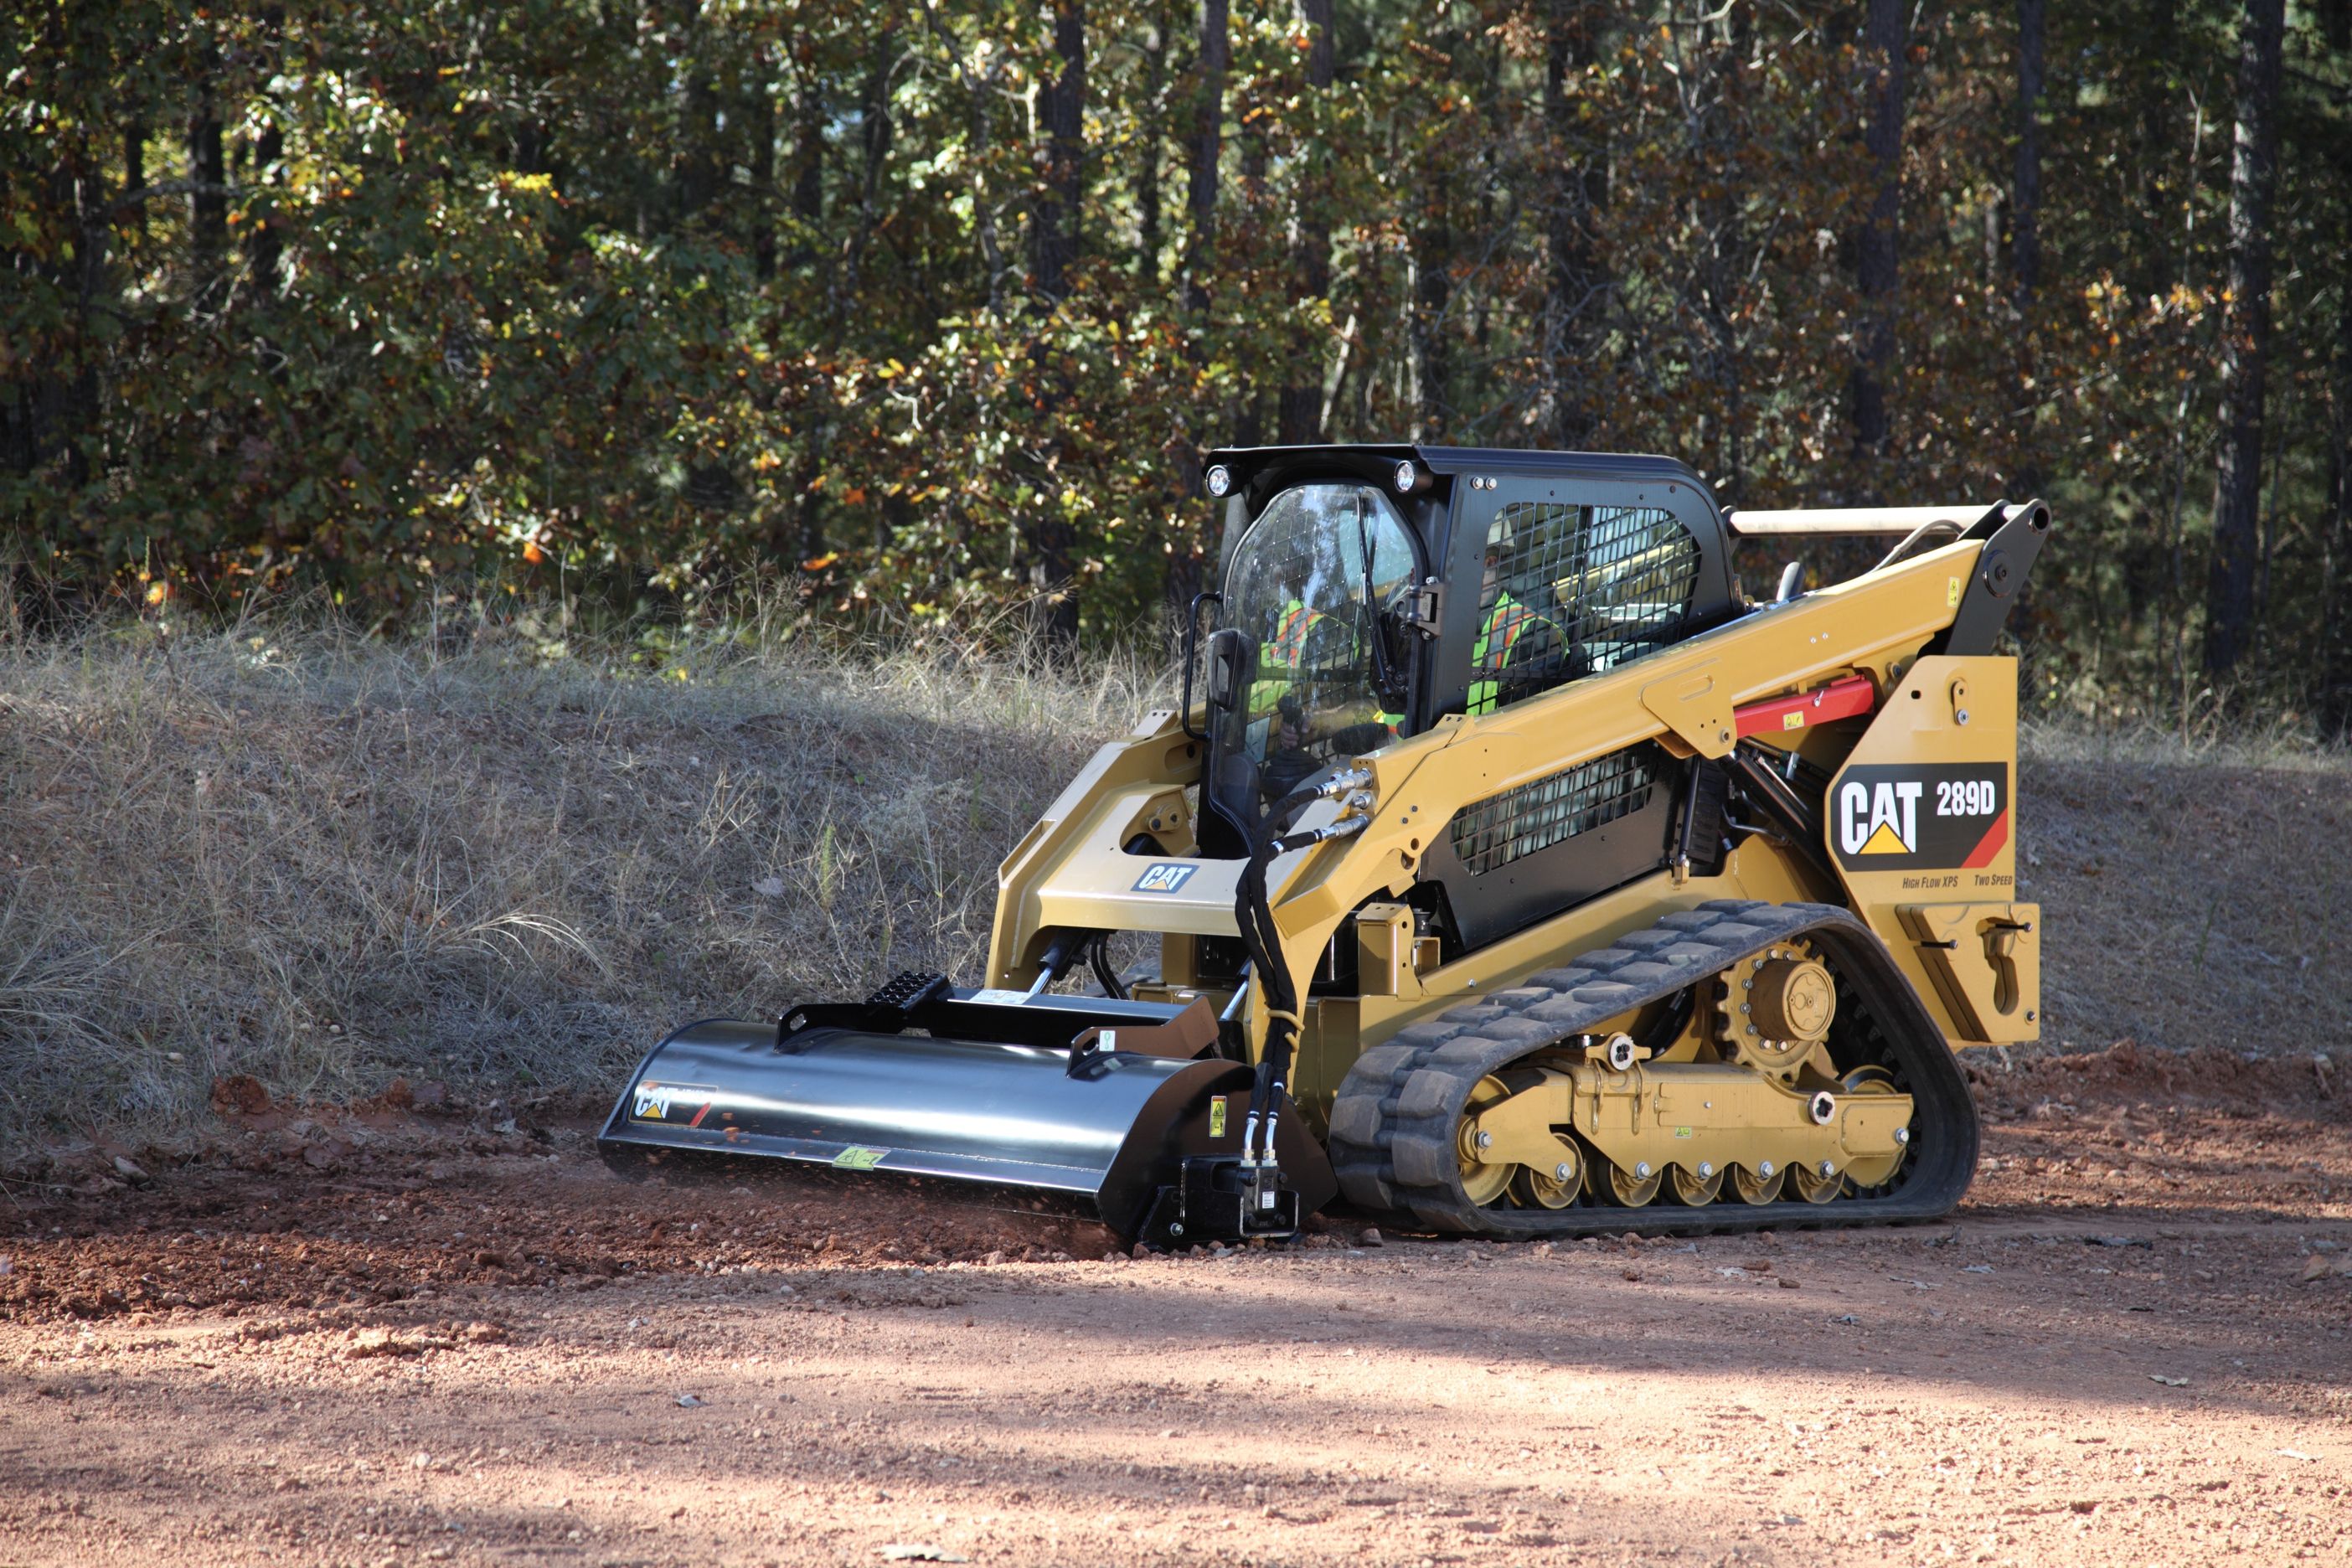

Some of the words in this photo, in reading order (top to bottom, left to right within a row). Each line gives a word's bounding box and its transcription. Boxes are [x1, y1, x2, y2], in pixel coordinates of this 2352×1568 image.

[1840, 781, 1922, 855] CAT
[1937, 781, 1995, 816] 289D
[1138, 865, 1193, 890] CAT
[1902, 877, 1920, 889] HIGH
[1921, 876, 1942, 888] FLOW
[1942, 875, 1958, 887] XPS
[1974, 874, 1989, 885] TWO
[1991, 874, 2013, 885] SPEED
[634, 1086, 679, 1119] CAT
